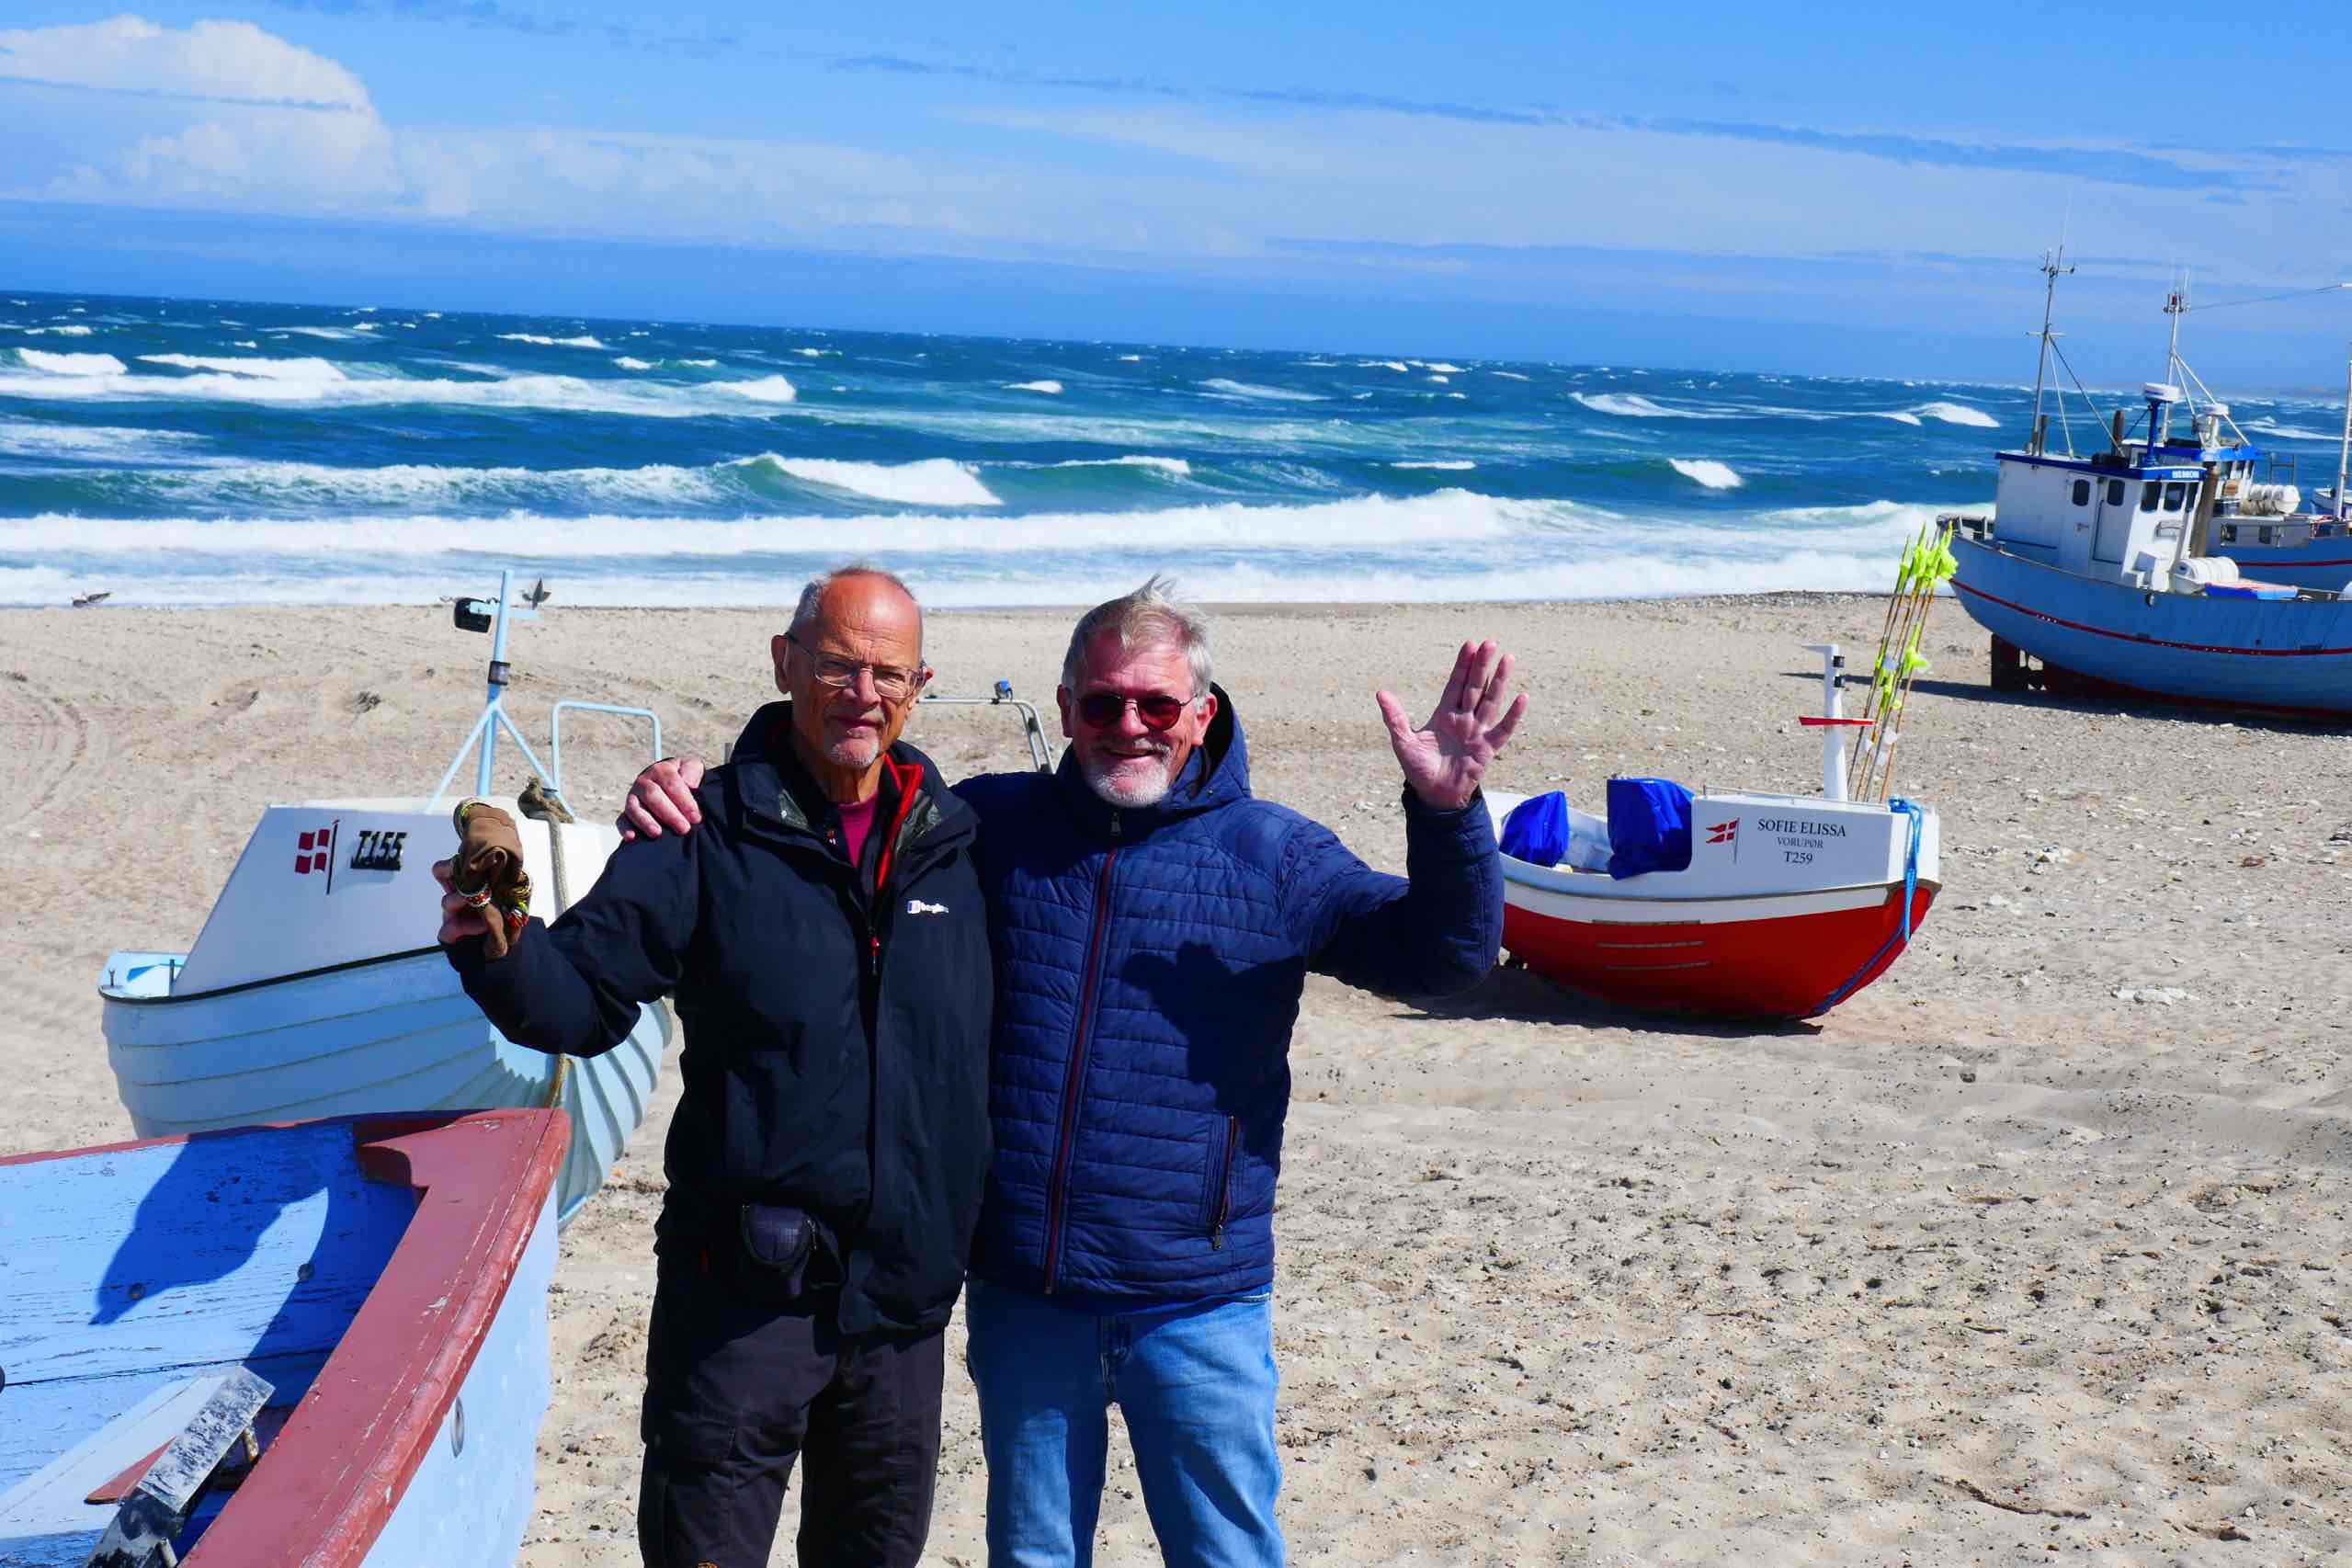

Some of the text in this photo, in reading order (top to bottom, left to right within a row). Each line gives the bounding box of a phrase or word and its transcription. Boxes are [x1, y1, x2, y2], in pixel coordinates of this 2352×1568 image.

[1757, 818, 1846, 837] SOFIE ELISSA
[351, 830, 407, 870] T155
[1784, 851, 1813, 864] T259
